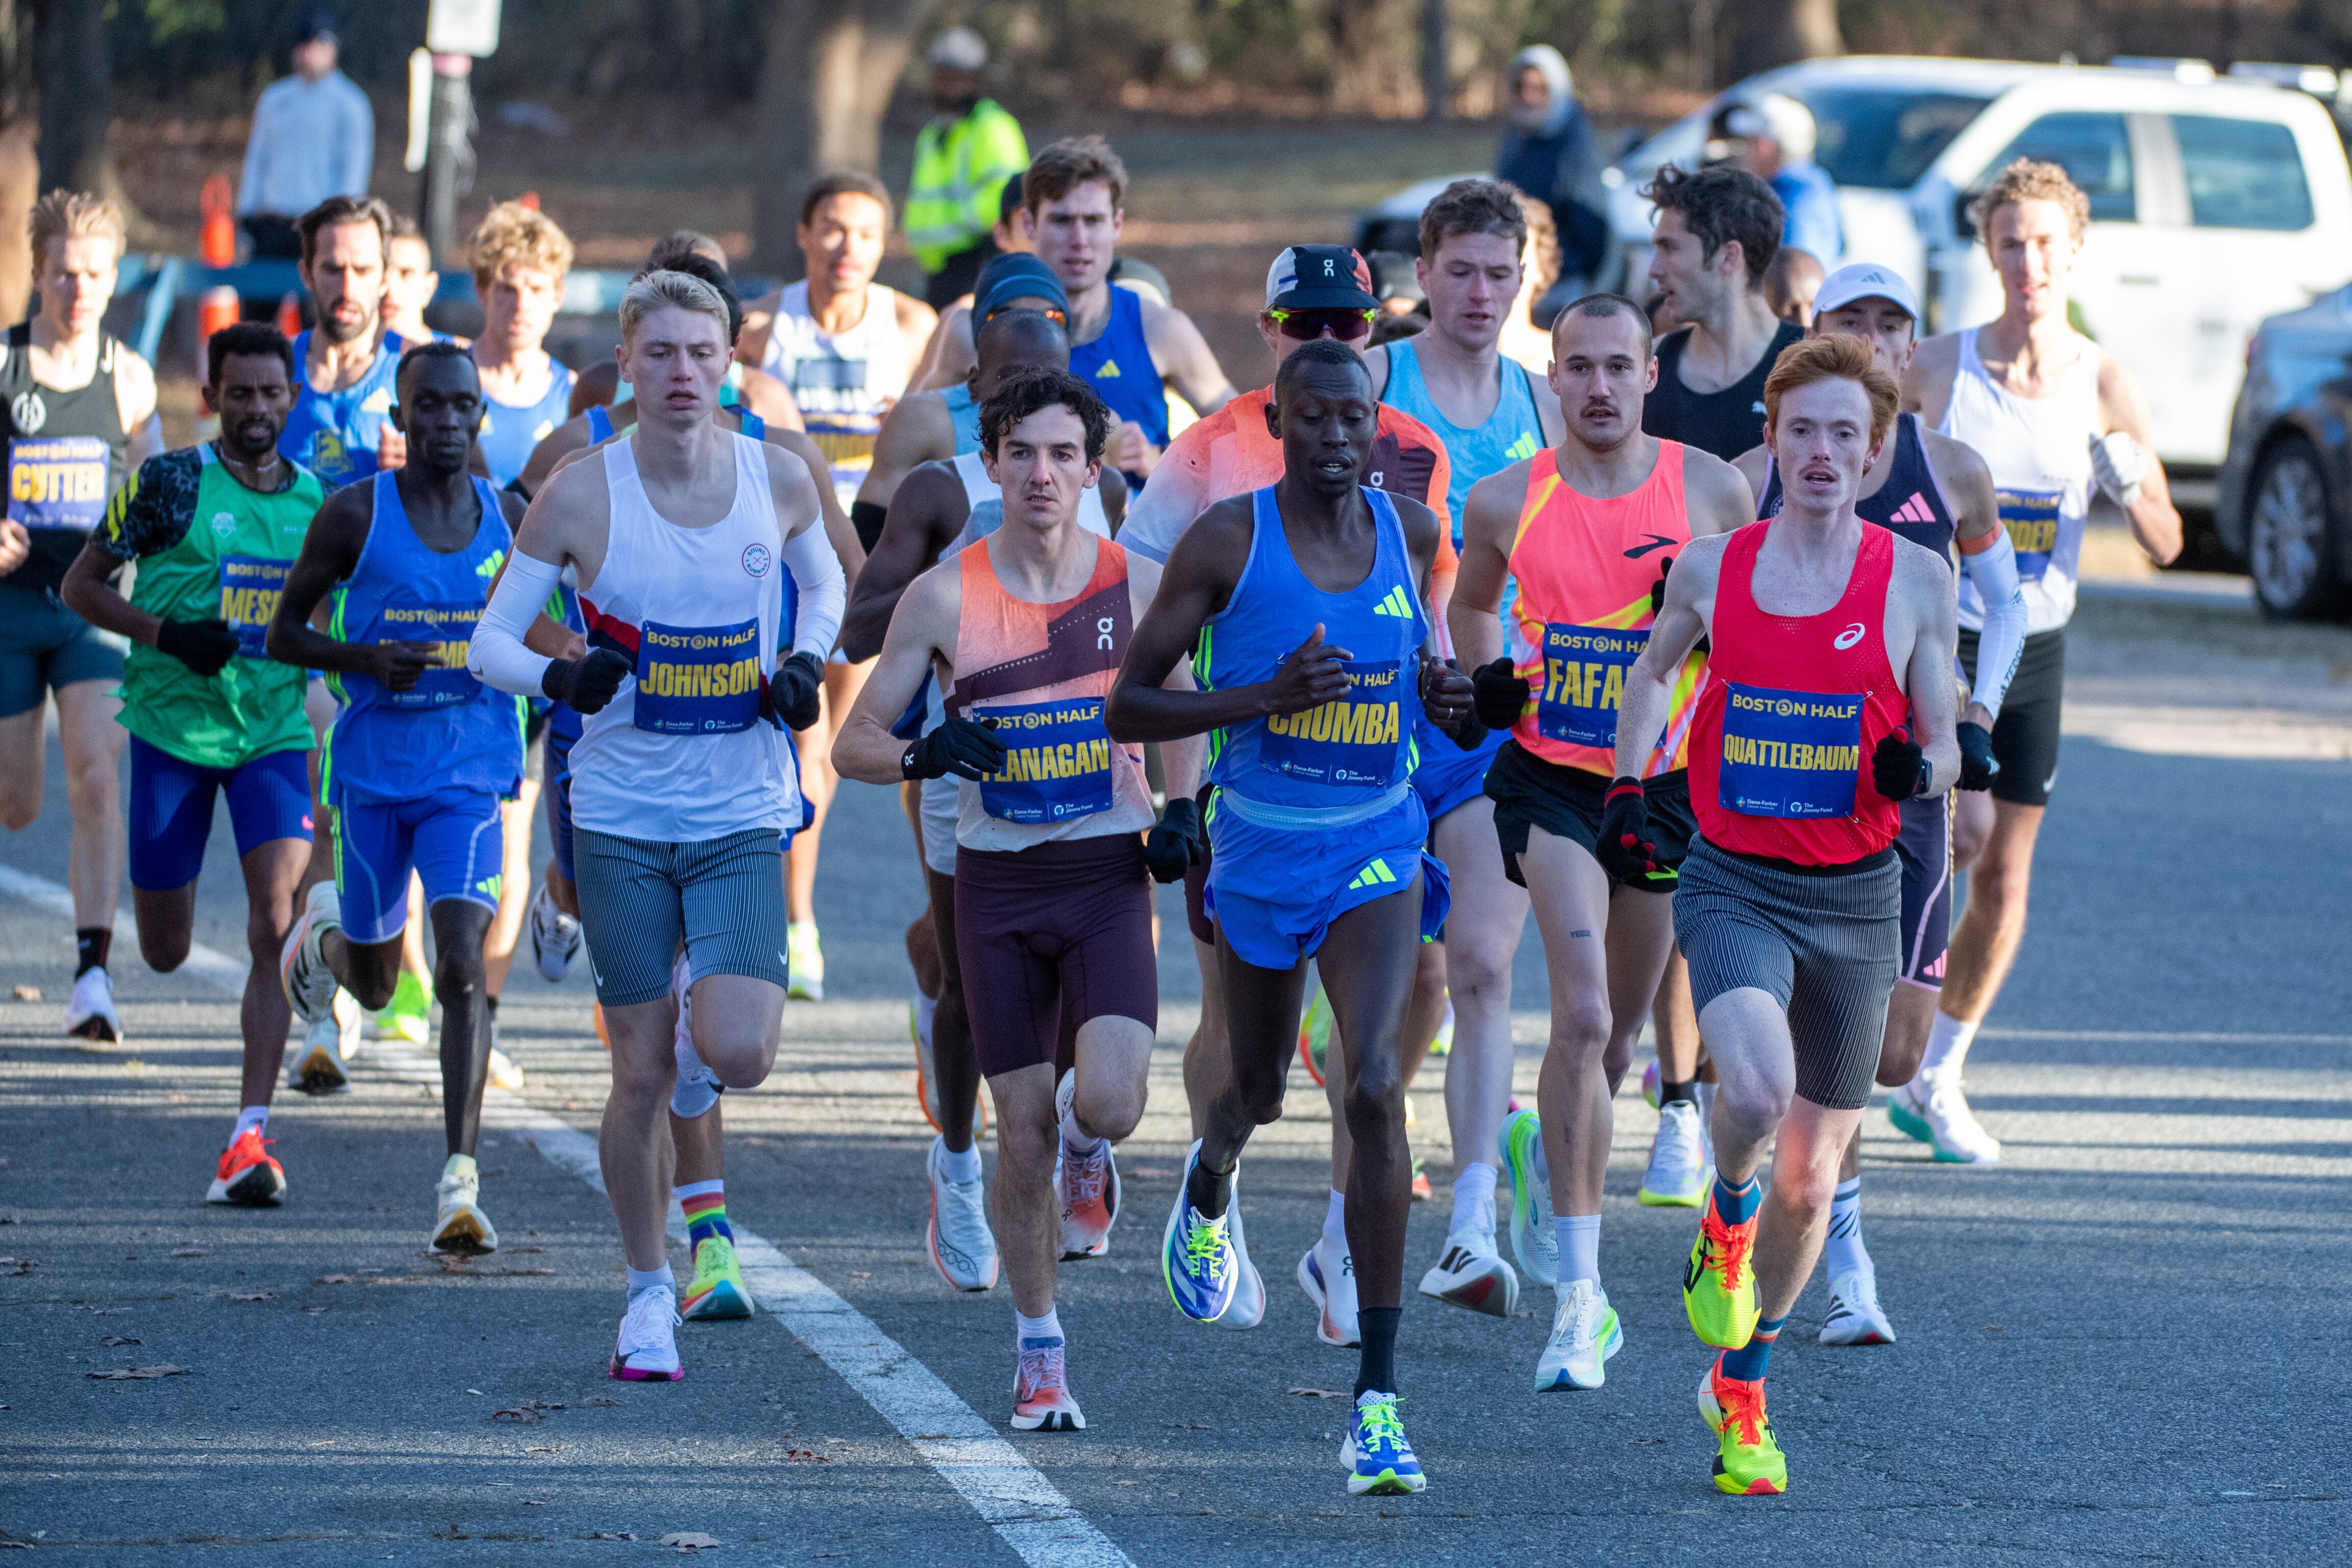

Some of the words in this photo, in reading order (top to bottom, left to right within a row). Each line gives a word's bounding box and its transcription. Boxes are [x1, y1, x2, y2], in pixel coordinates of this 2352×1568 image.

[12, 462, 106, 503] CUTTER
[748, 547, 765, 556] SOUND
[227, 562, 282, 580] BOSTON
[747, 563, 768, 574] RUNNING
[385, 608, 449, 625] BOSTON
[648, 631, 719, 650] BOSTON
[722, 628, 755, 647] HALF
[1549, 633, 1622, 653] BOSTON
[1626, 639, 1650, 654] HA
[639, 656, 759, 698] JOHNSON
[1364, 671, 1395, 687] HALF
[1732, 693, 1806, 716] BOSTON
[1811, 704, 1858, 718] HALF
[1056, 706, 1100, 724] HALF
[1568, 728, 1596, 738] Dana-Farber
[982, 738, 1109, 782] LANAGAN
[1723, 733, 1859, 771] QUATTLEBAUM
[1293, 764, 1325, 774] Dana-Farber
